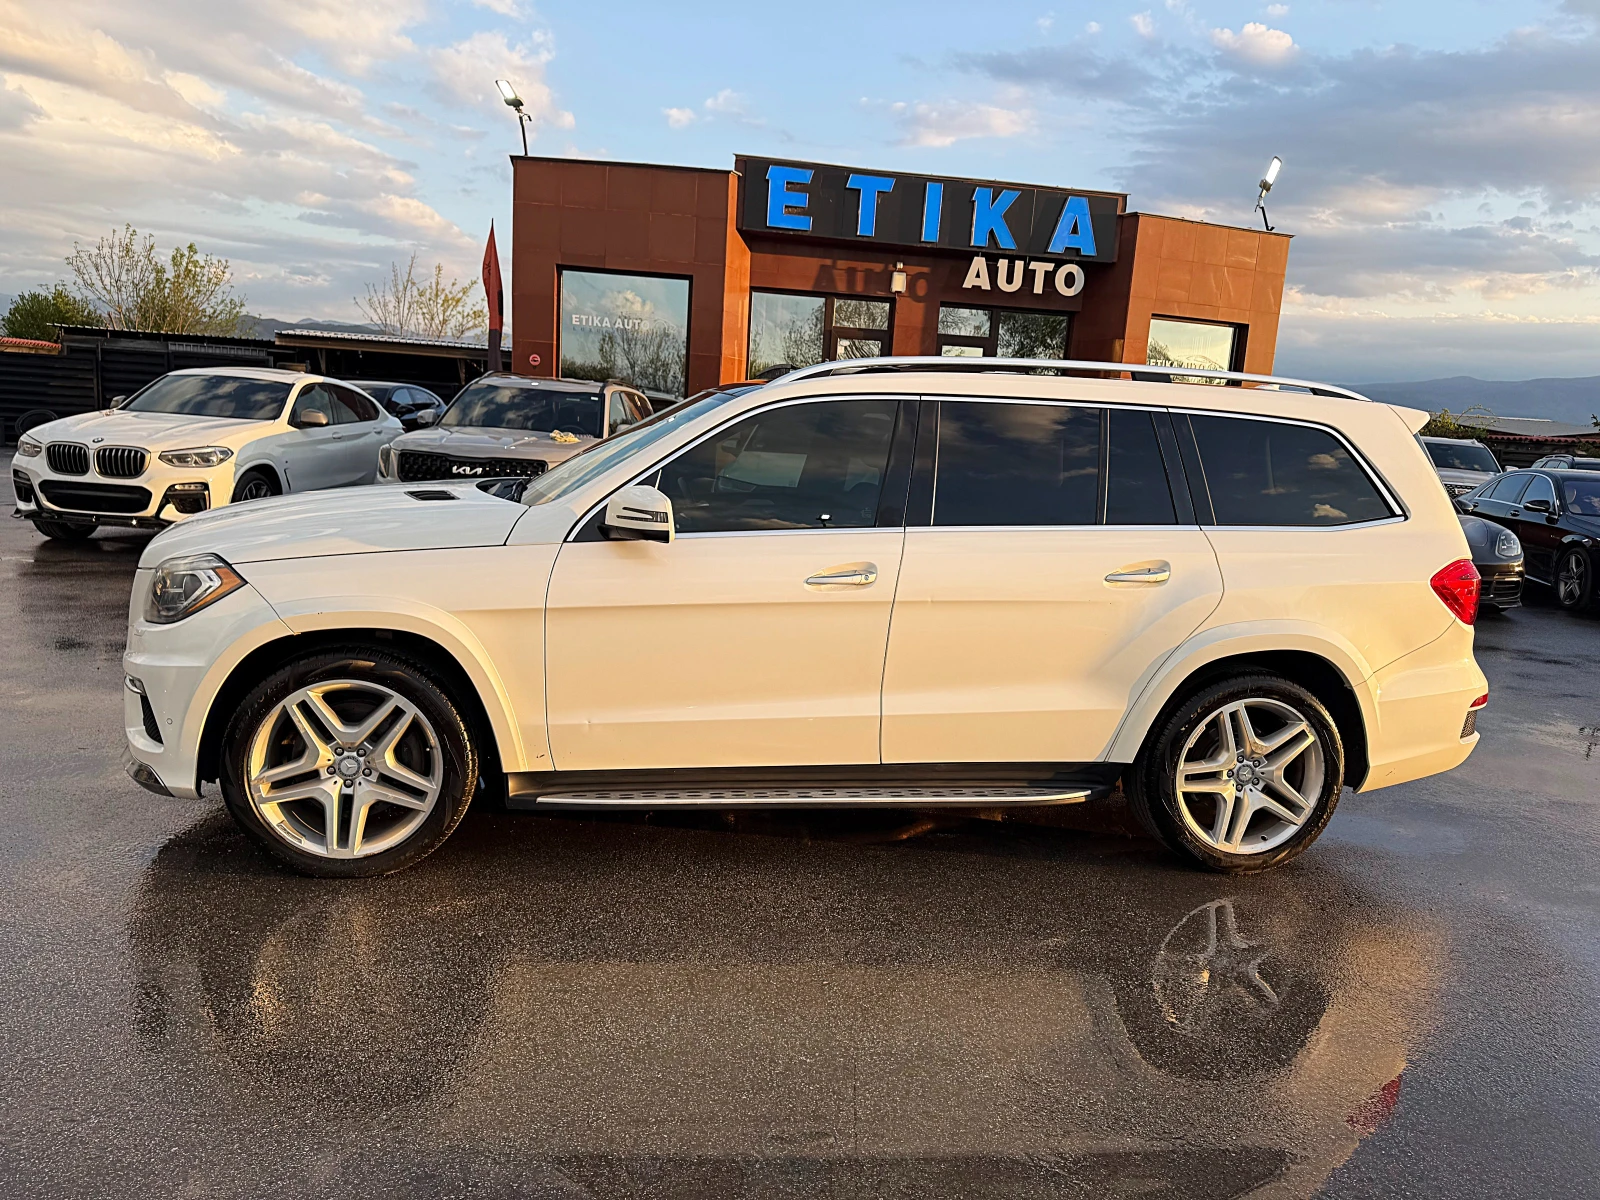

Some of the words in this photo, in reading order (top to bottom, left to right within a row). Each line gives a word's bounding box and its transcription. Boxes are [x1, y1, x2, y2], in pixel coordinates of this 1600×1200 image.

[766, 165, 1096, 257] ETIKA
[962, 256, 1085, 297] AUTO
[572, 314, 611, 328] ETIKA
[614, 318, 650, 330] AUTO
